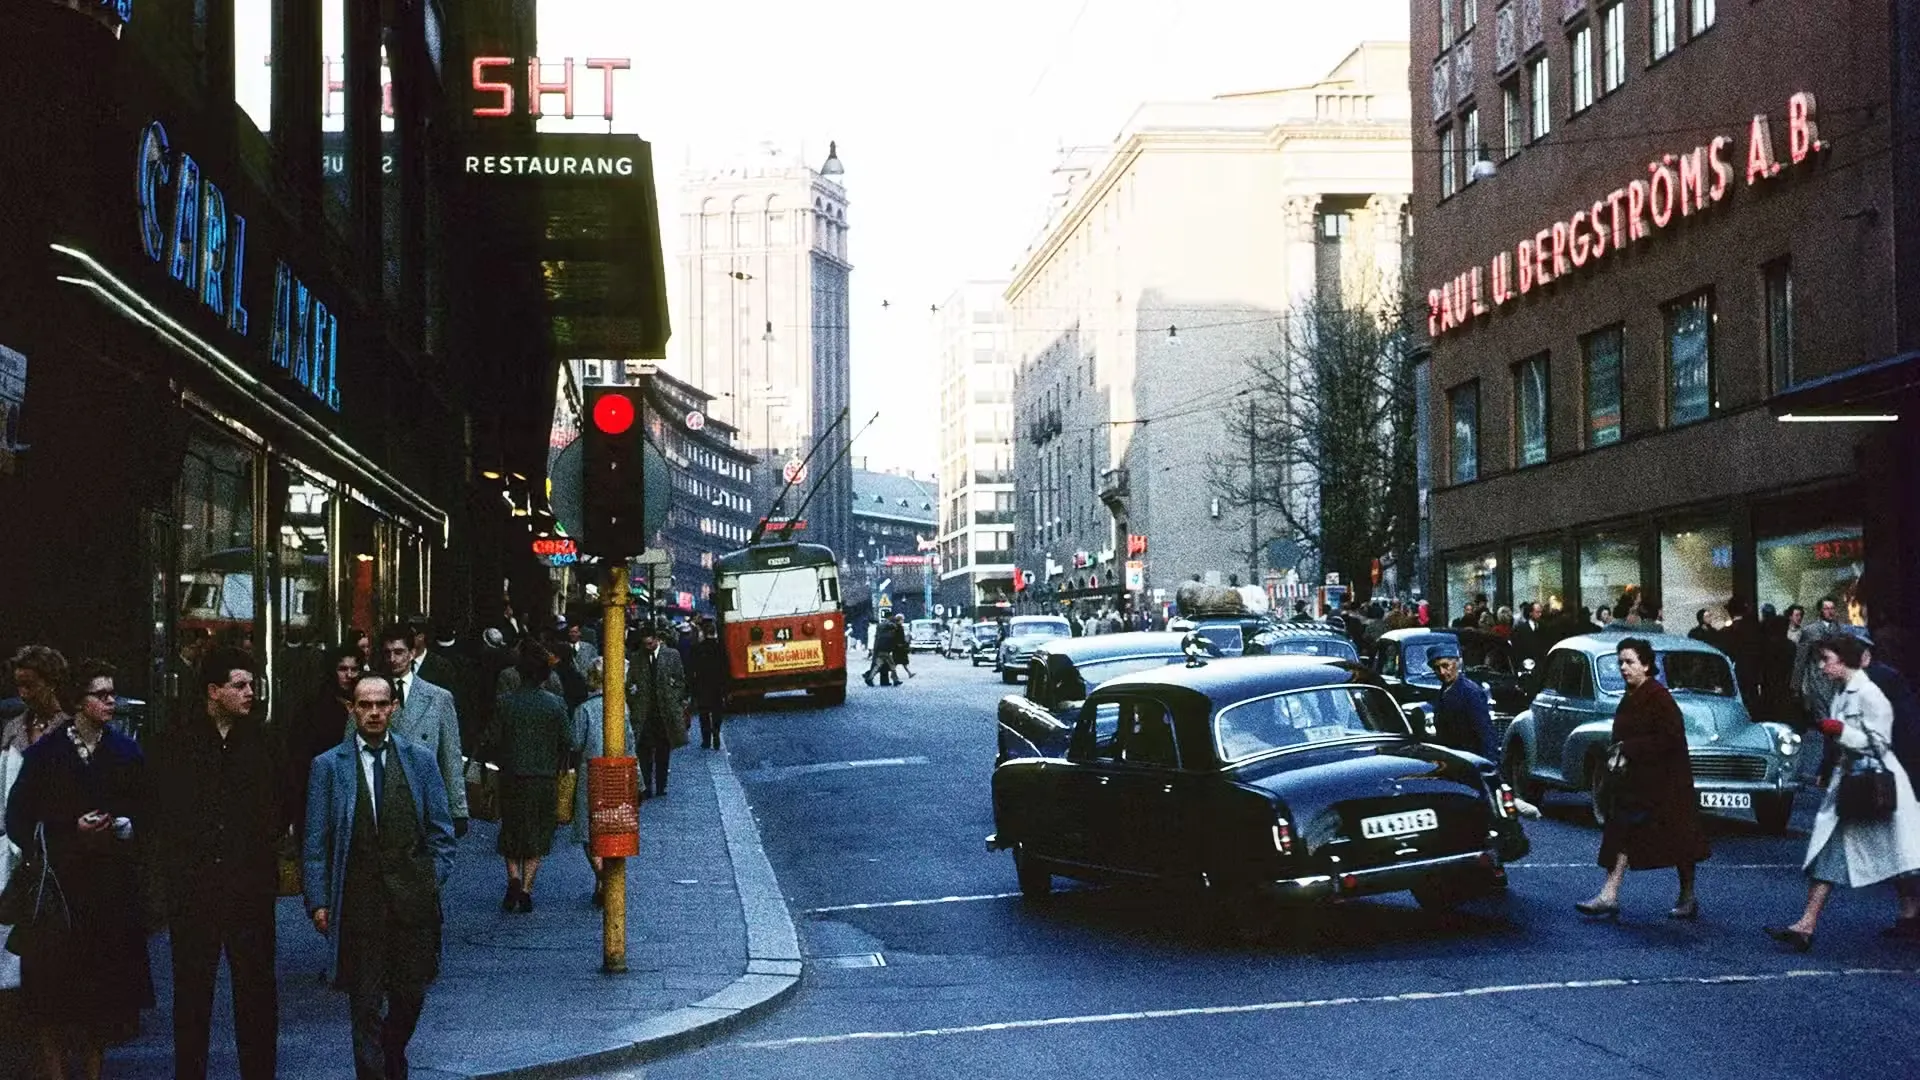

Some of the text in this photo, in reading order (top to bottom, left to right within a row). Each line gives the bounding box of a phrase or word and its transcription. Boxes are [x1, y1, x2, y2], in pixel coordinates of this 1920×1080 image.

[472, 56, 631, 120] SHT
[465, 155, 634, 176] RESTAURANG
[138, 120, 248, 337] CARL
[1428, 265, 1487, 337] PAUL
[1492, 250, 1516, 305] U.
[1518, 135, 1734, 294] BERGSTRÖMS
[776, 628, 791, 640] 41
[766, 647, 820, 663] RAGGMUNK
[1702, 793, 1750, 807] K24260
